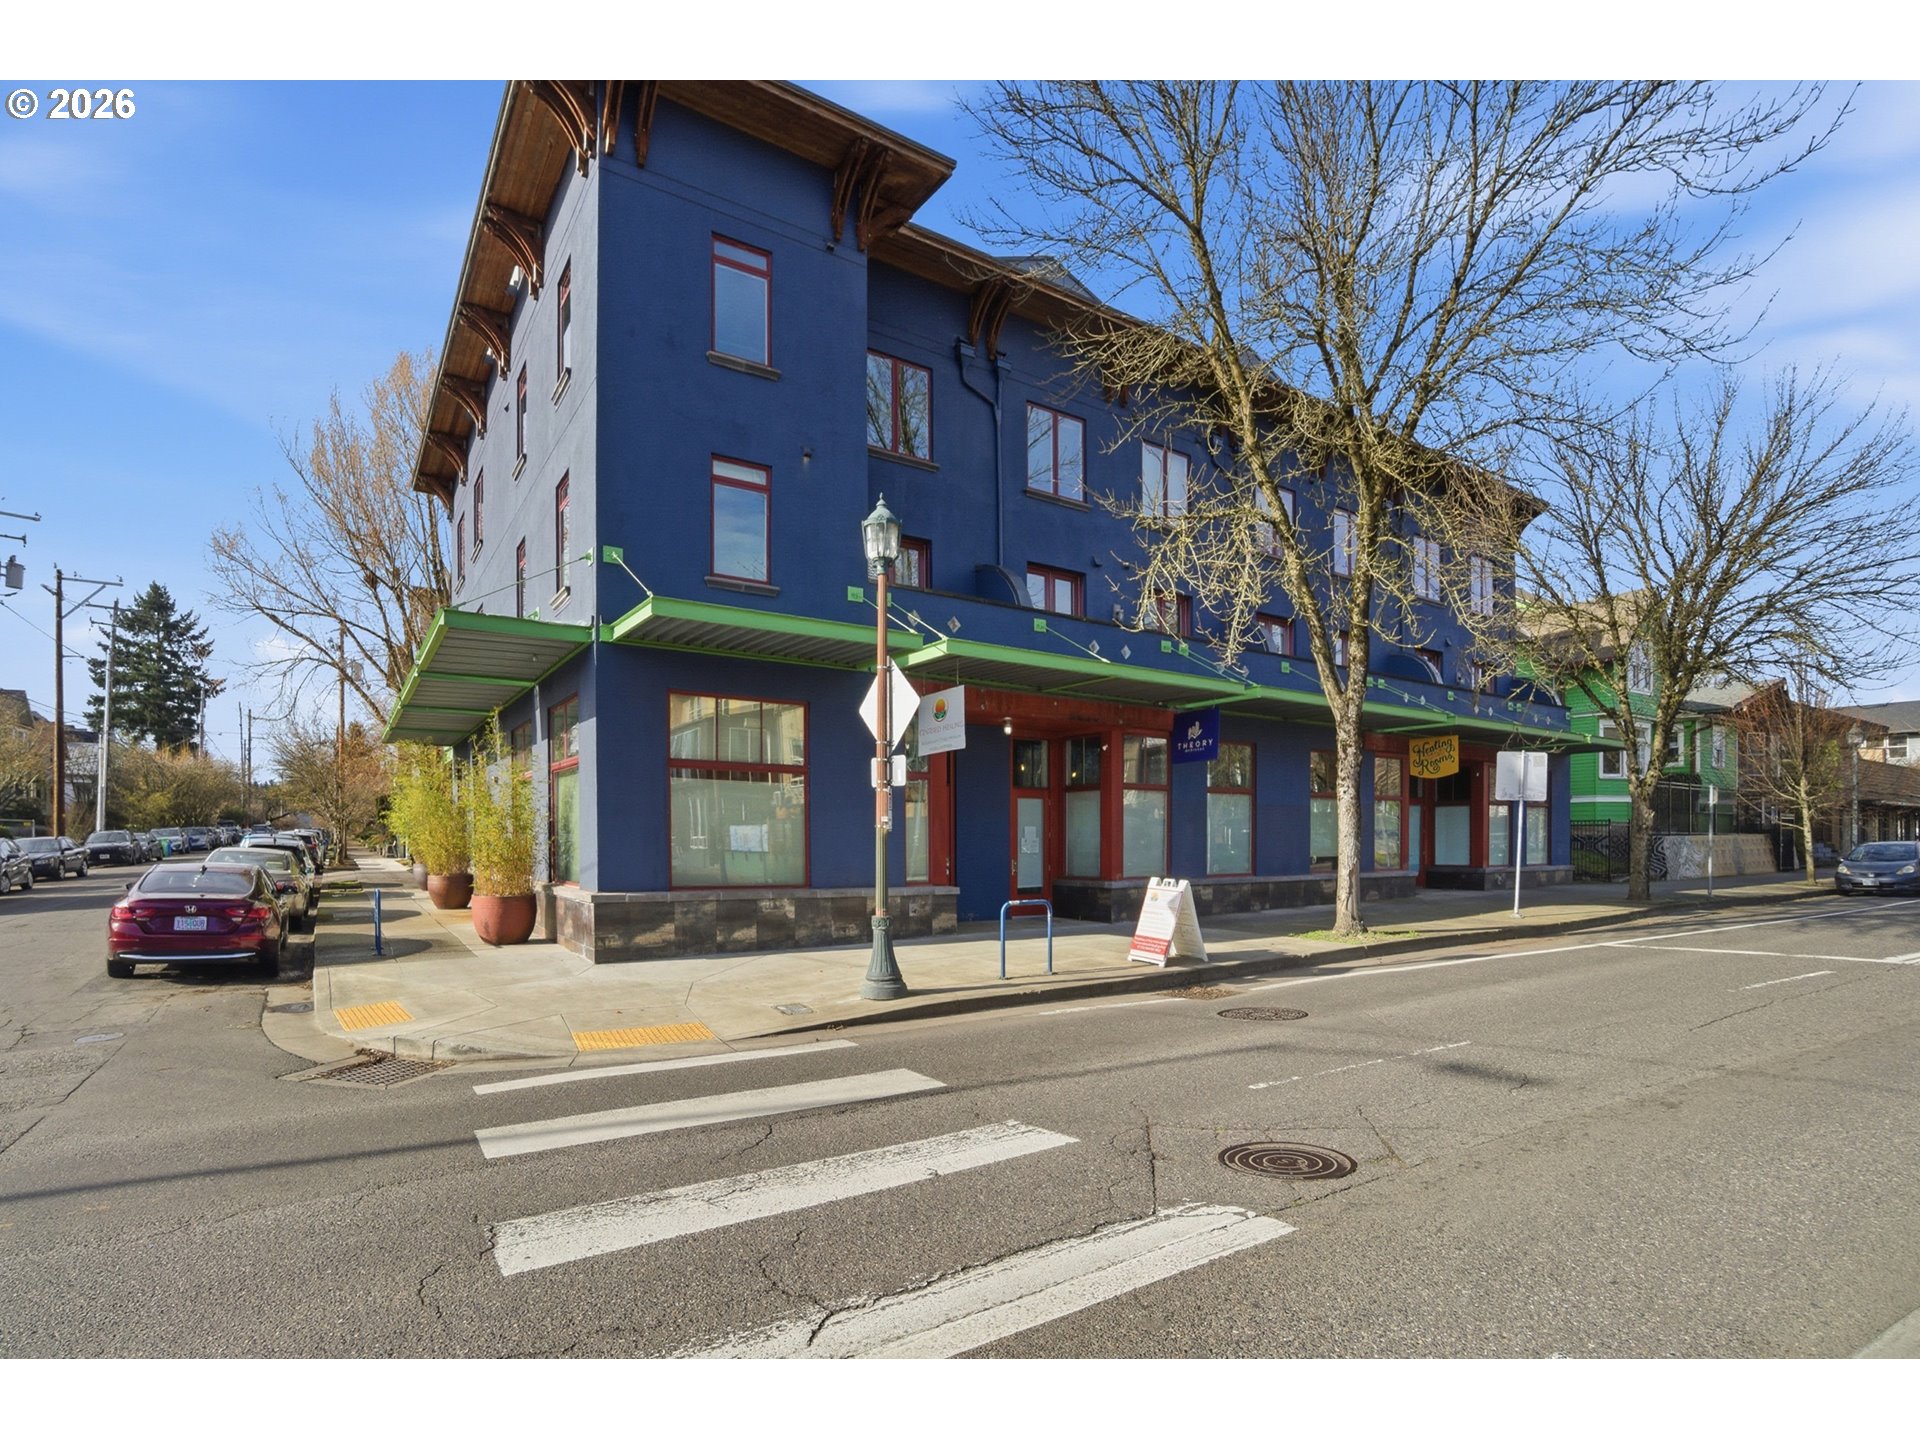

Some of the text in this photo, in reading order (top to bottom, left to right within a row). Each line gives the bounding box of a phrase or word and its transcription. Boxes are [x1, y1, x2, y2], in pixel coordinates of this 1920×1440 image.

[1178, 738, 1213, 750] THEORY
[1412, 739, 1455, 767] Healing
[1418, 754, 1455, 775] Rooms
